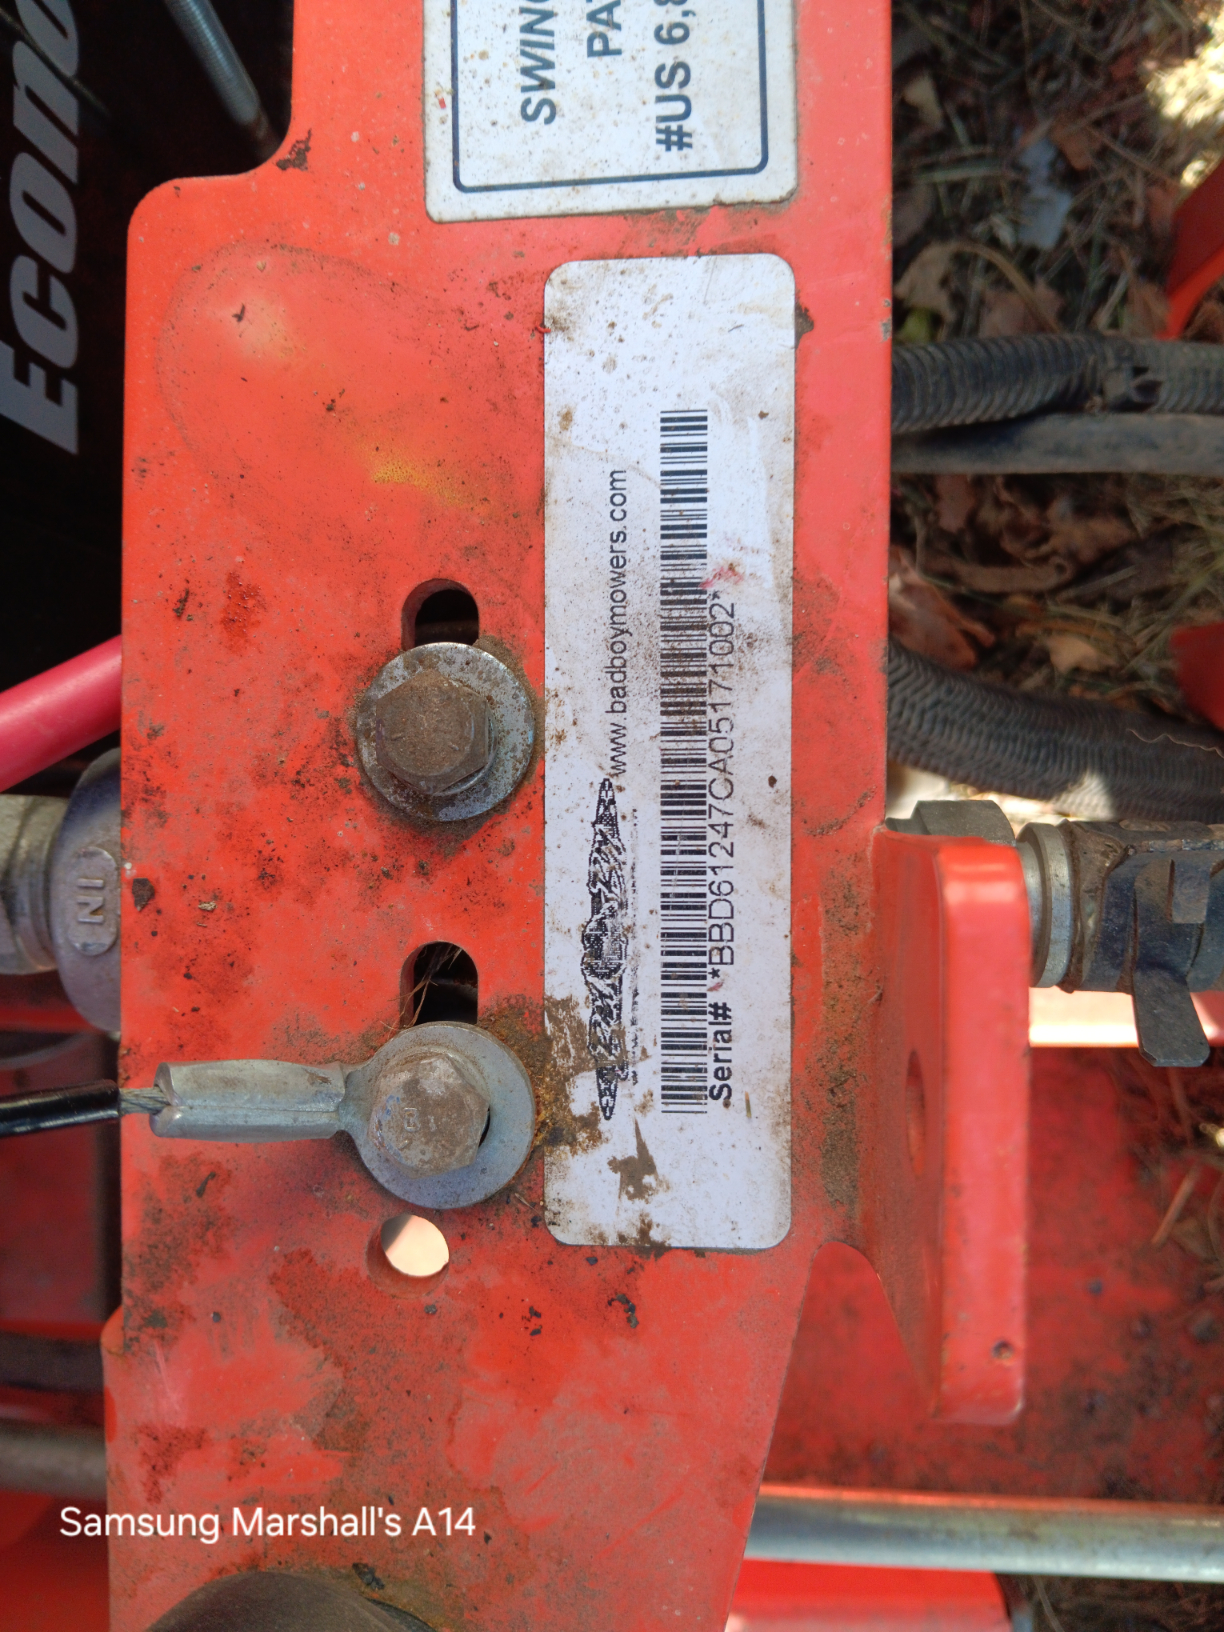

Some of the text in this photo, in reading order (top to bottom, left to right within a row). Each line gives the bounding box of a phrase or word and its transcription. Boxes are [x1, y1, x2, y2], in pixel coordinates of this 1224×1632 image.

[520, 0, 557, 125] SWIN
[586, 0, 623, 58] PA
[653, 0, 697, 151] #US 6,
[605, 469, 632, 776] www.badboymowers.com
[708, 1002, 732, 1101] Serial#
